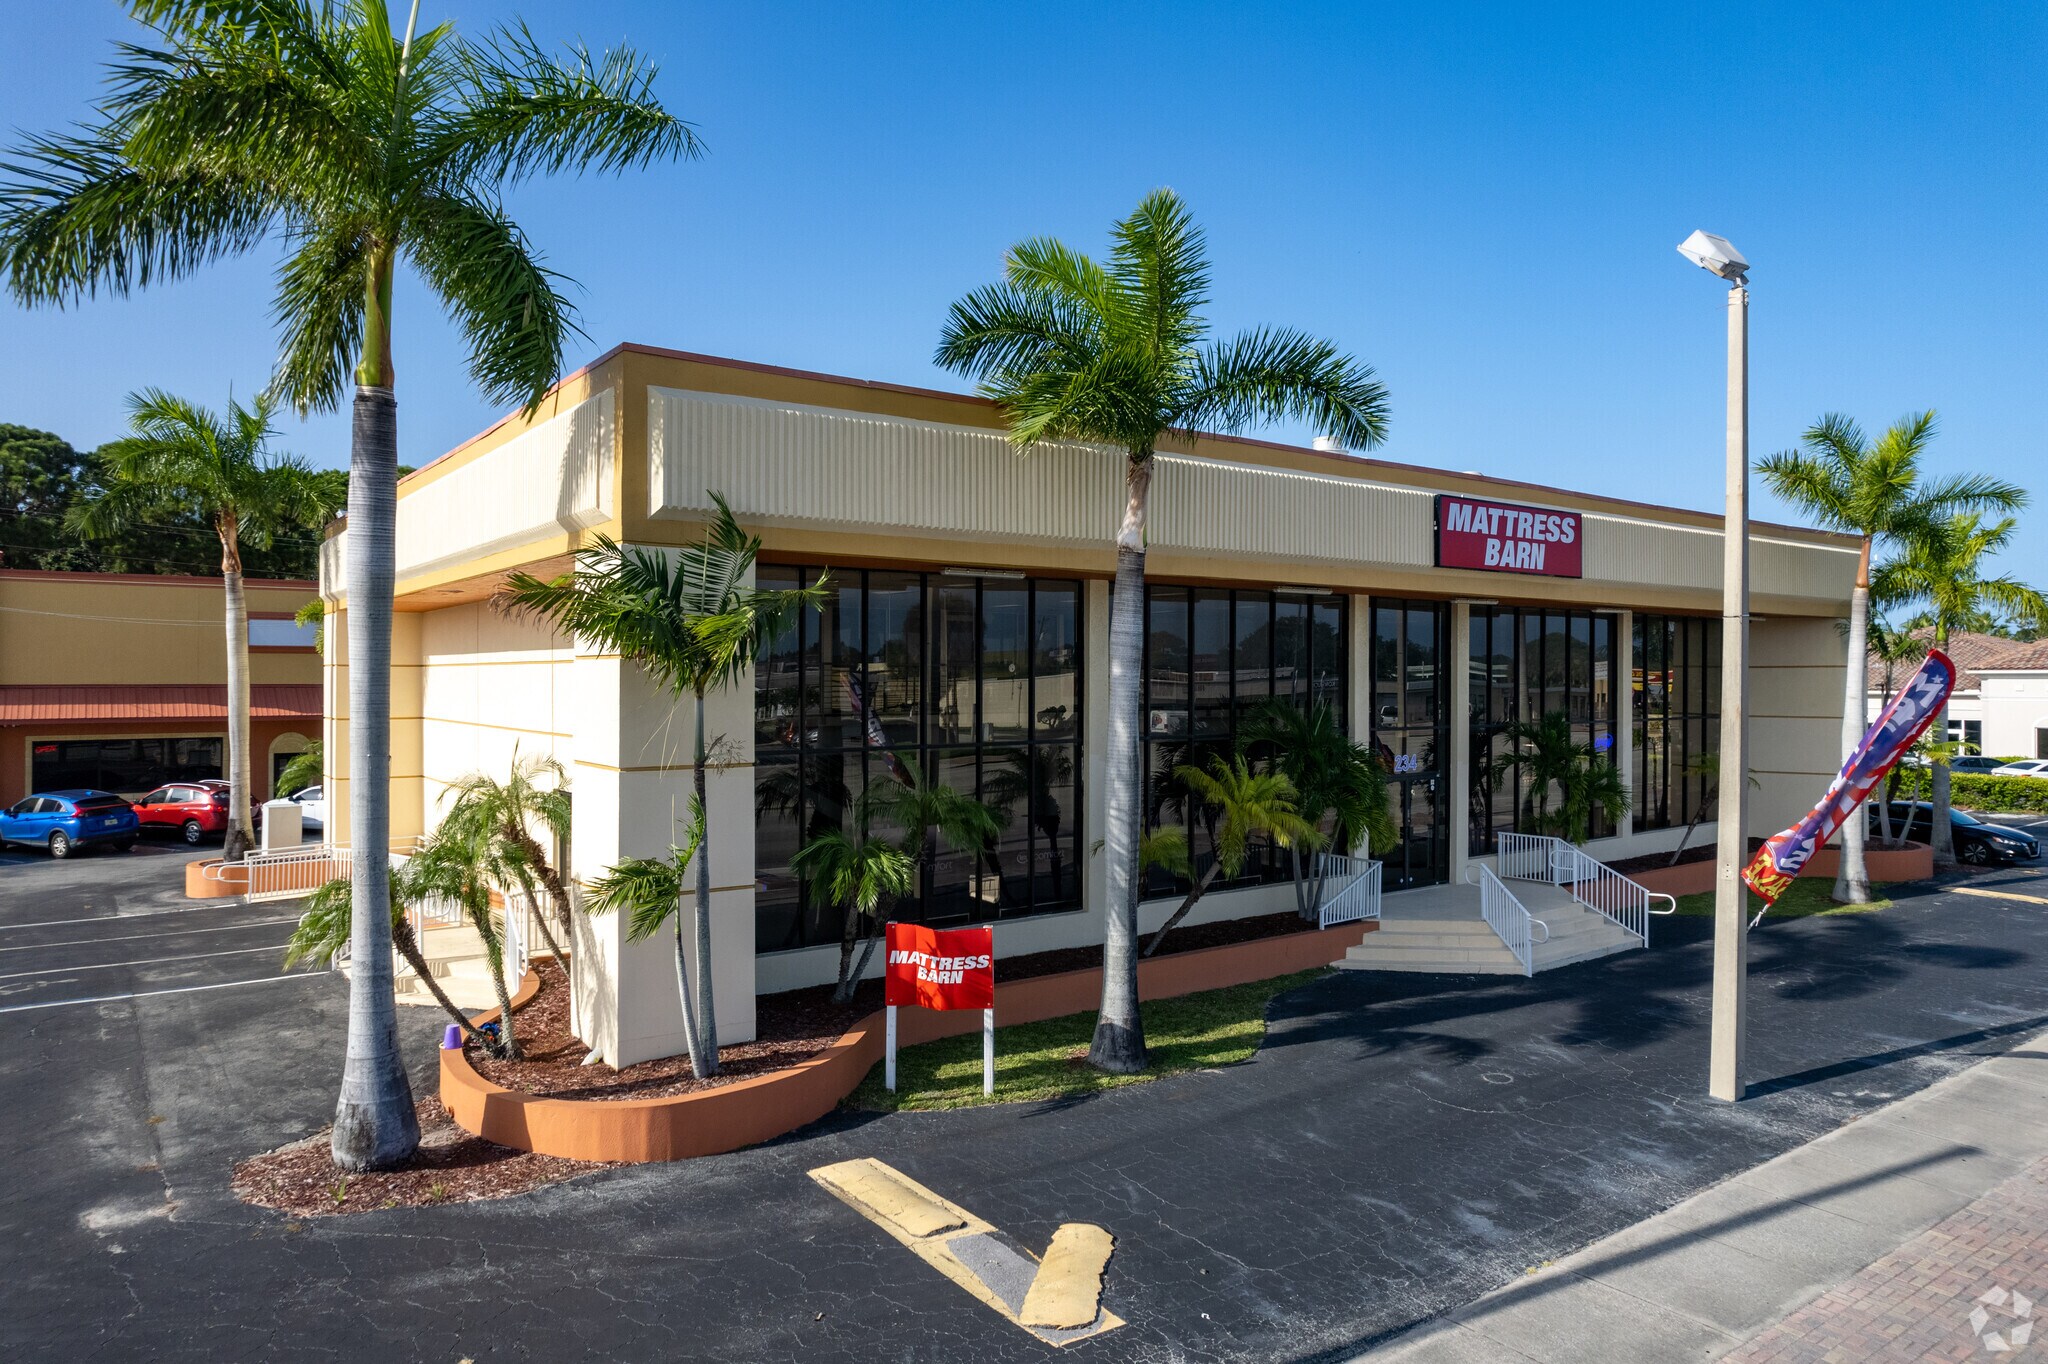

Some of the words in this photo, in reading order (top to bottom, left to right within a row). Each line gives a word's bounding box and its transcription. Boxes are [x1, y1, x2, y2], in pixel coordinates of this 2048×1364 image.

[1447, 502, 1576, 544] MATTRESS
[1484, 538, 1546, 570] BARN
[1394, 754, 1418, 772] 234
[889, 950, 990, 970] MATTRESS
[917, 966, 964, 984] BARN
